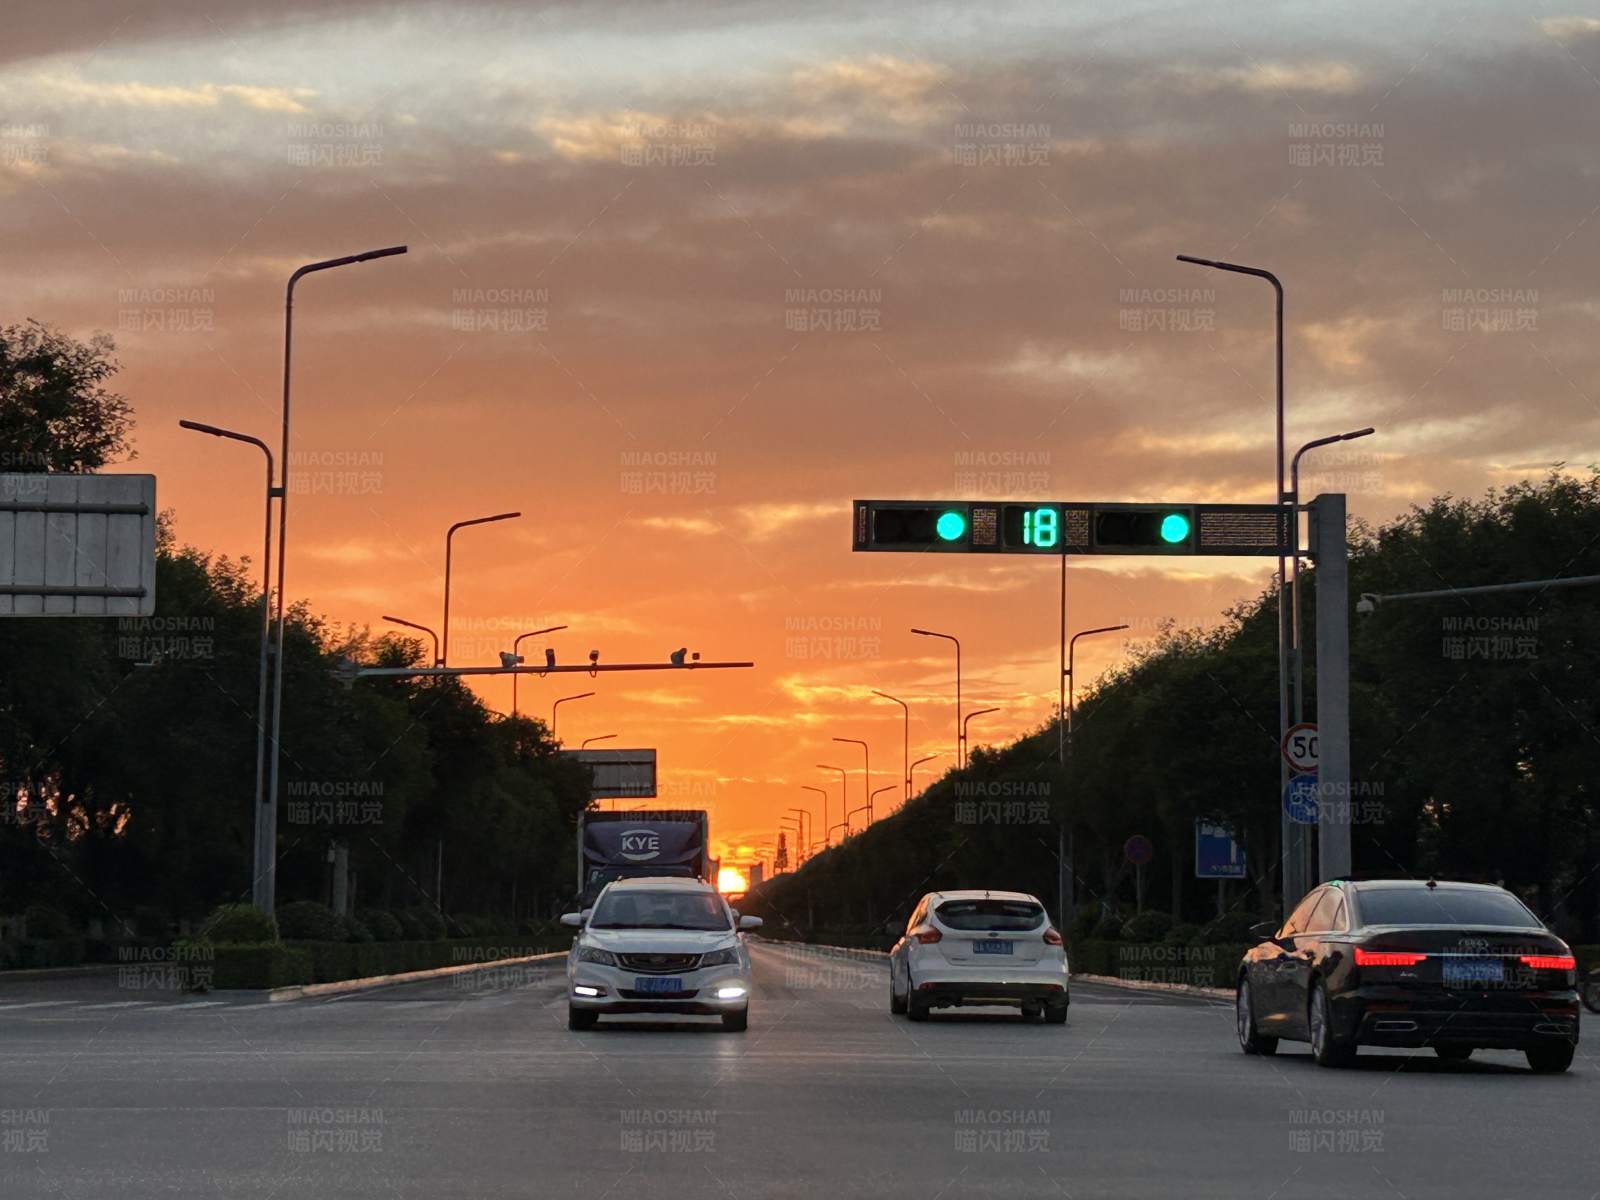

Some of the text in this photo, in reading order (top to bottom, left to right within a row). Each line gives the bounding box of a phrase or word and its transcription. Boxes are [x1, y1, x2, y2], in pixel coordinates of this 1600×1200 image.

[1023, 508, 1057, 547] 18
[1293, 736, 1319, 759] 50
[621, 836, 660, 851] KYE
